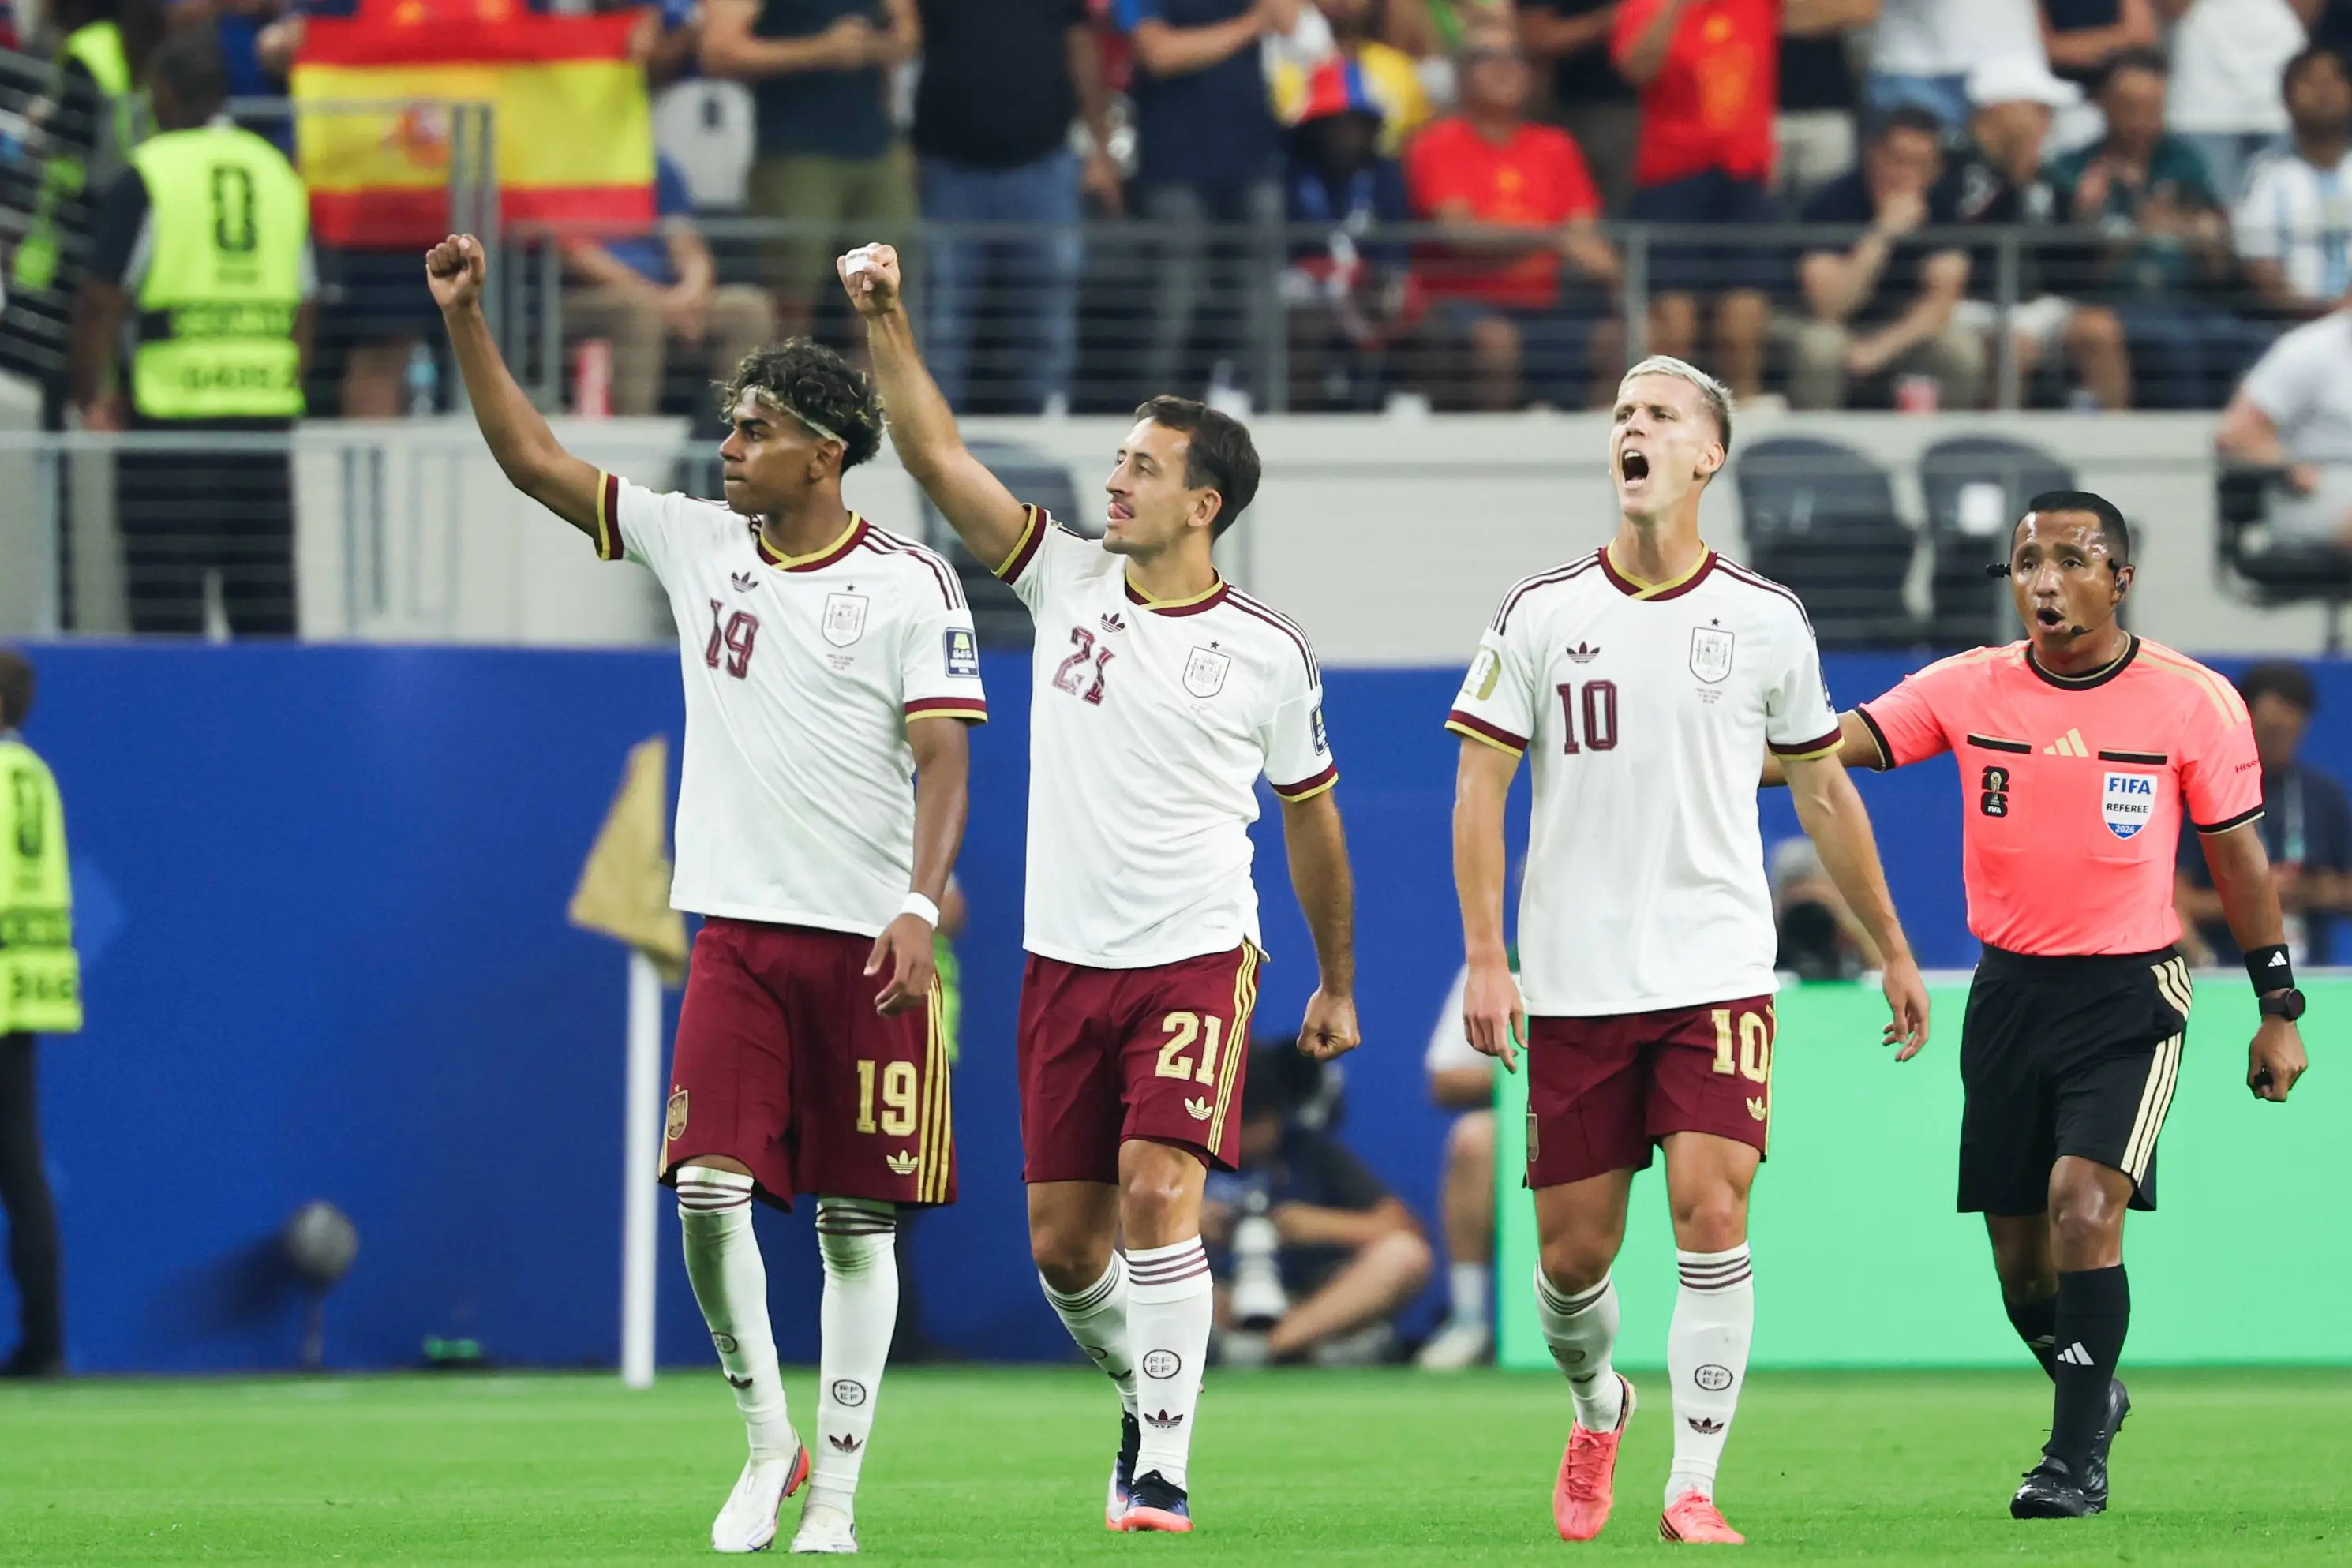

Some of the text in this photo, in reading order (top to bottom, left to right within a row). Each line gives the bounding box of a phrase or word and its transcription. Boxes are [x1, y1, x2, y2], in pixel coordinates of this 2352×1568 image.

[706, 597, 759, 679] 19
[1051, 625, 1116, 707] 21
[1556, 679, 1617, 755] 10
[2107, 803, 2148, 814] REFEREE
[2108, 777, 2151, 795] FIFA
[2115, 825, 2135, 833] 2026
[1155, 1012, 1222, 1087] 21
[1711, 1009, 1769, 1084] 10
[856, 1059, 917, 1136] 19
